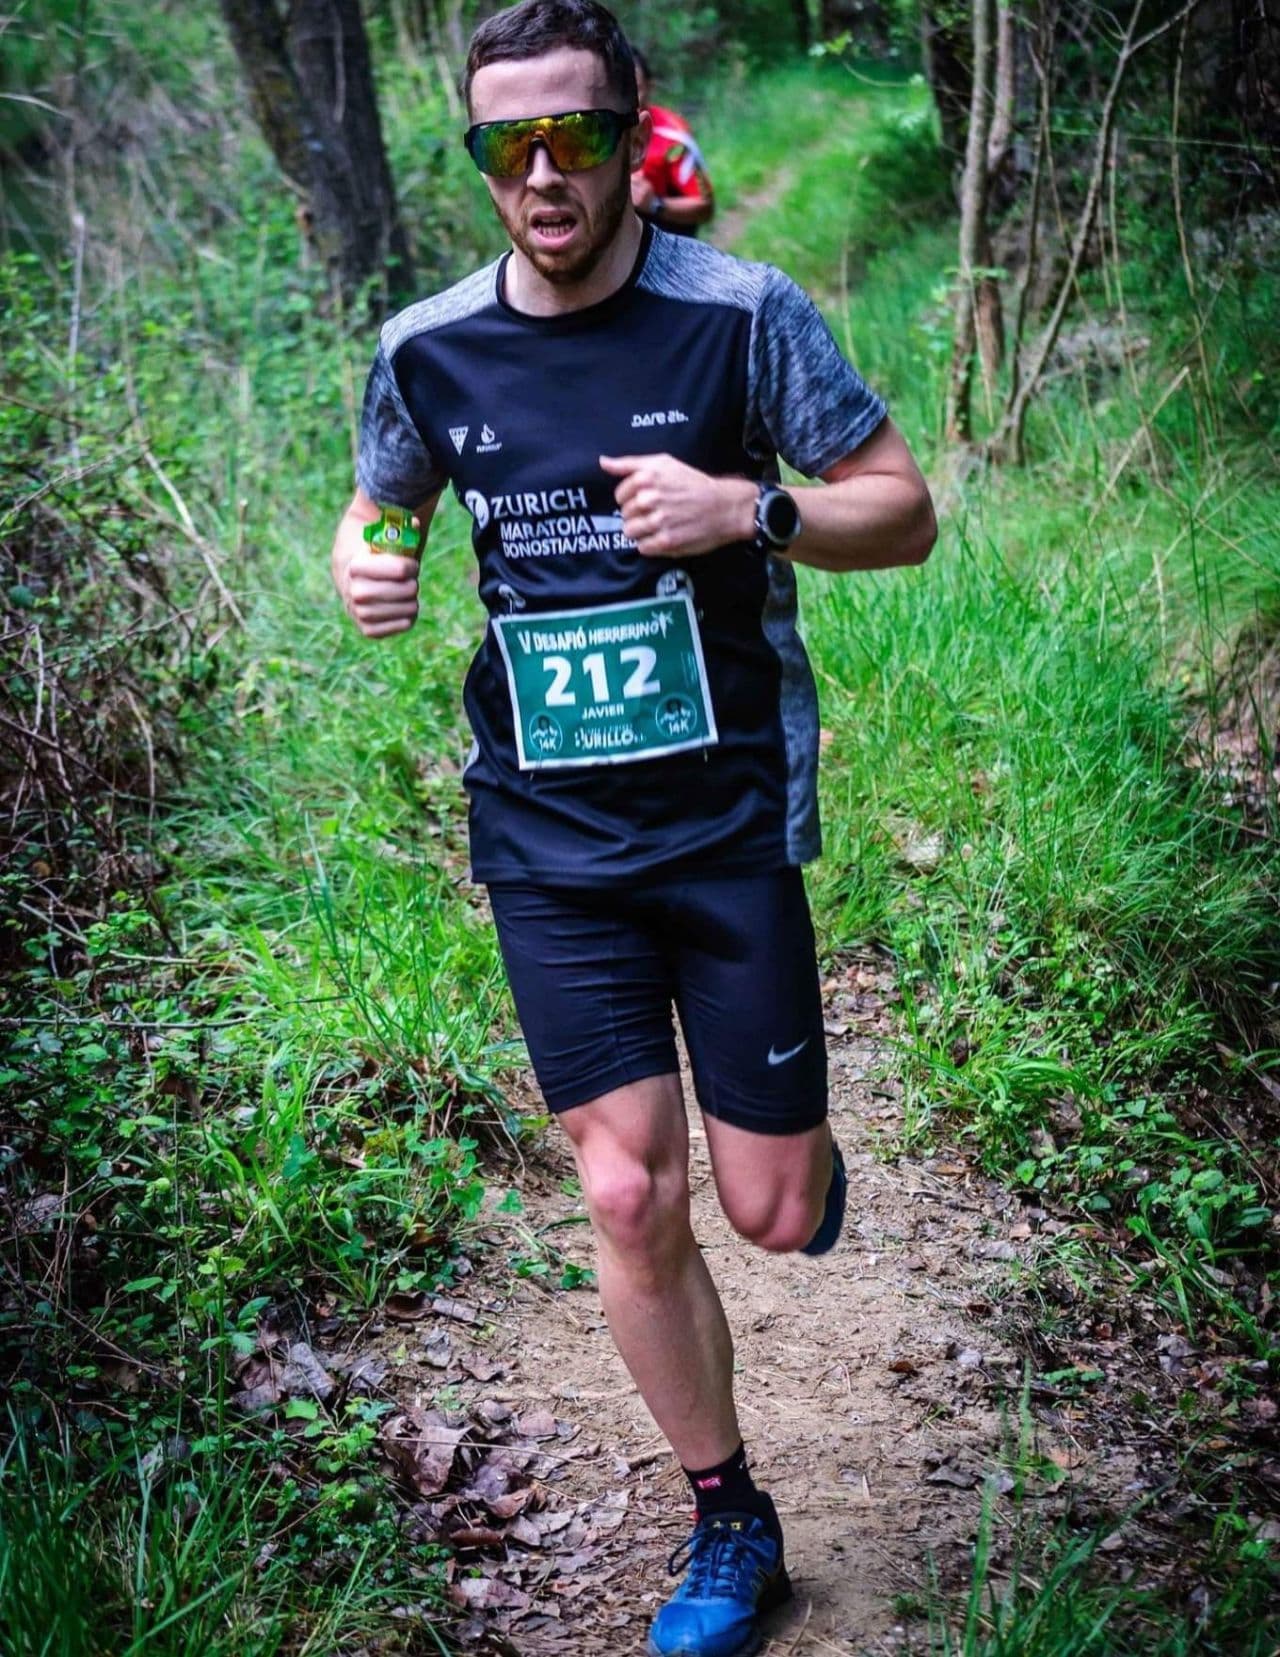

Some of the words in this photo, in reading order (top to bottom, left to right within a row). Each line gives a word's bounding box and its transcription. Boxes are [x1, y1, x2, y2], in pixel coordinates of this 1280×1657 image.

[491, 488, 588, 519] ZURICH
[500, 515, 591, 541] MARATOIA
[503, 535, 610, 559] DONOSTIA/SAN
[518, 629, 532, 655] V
[542, 645, 661, 707] 212
[582, 703, 624, 720] JAVIER
